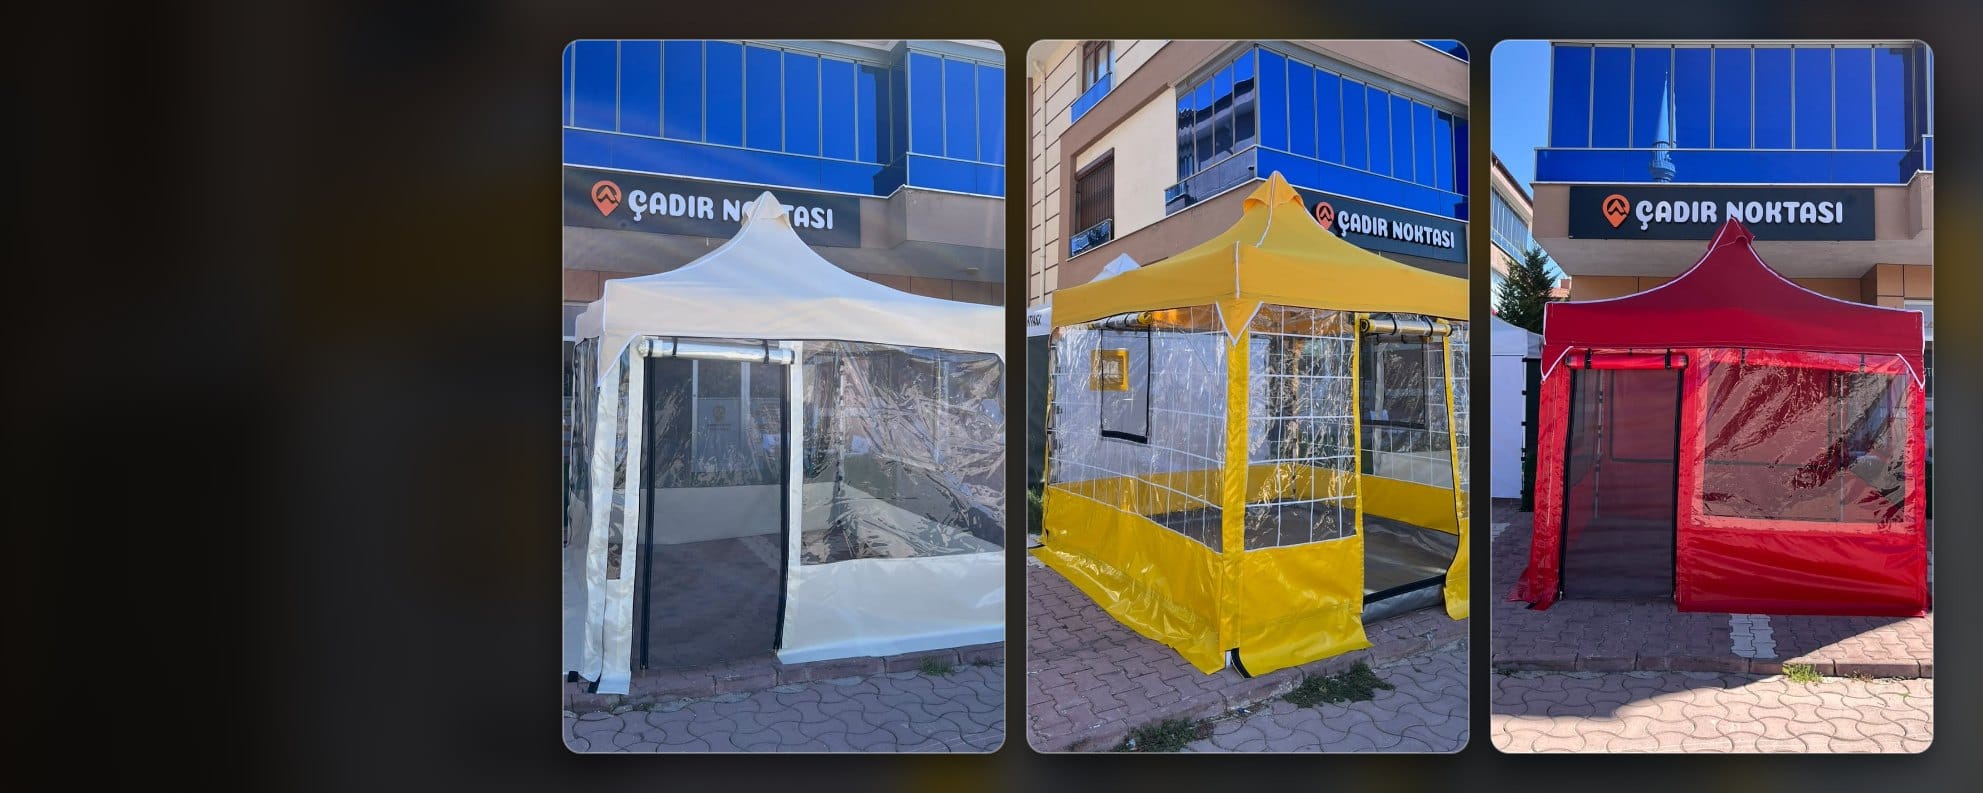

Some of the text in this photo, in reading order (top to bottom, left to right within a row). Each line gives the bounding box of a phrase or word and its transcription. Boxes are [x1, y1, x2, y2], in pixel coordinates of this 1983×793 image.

[628, 189, 834, 230] ÇADIR NTASI
[1635, 200, 1843, 231] ÇADIR NOKTASI
[1337, 210, 1455, 249] ÇADIR NOKTASI
